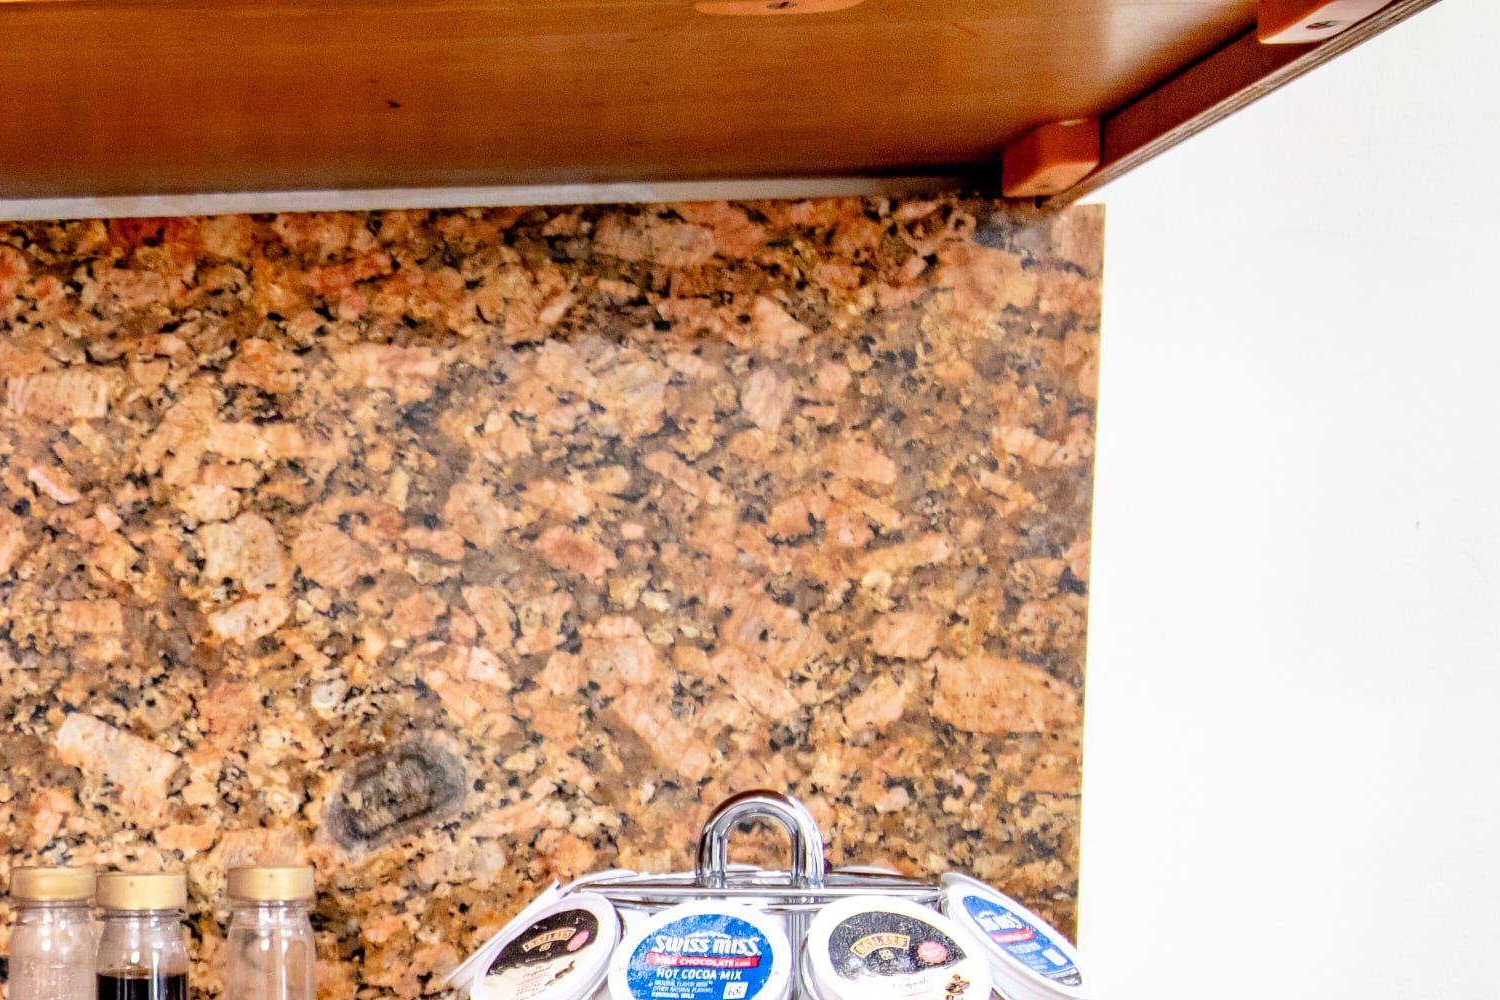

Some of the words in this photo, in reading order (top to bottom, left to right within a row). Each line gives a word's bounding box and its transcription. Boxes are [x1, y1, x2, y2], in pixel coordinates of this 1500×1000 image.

[652, 934, 709, 953] SWISS
[679, 958, 735, 967] CHOCOLATE
[656, 967, 678, 978] HOT
[681, 969, 717, 980] COCOA
[720, 970, 743, 981] MIX
